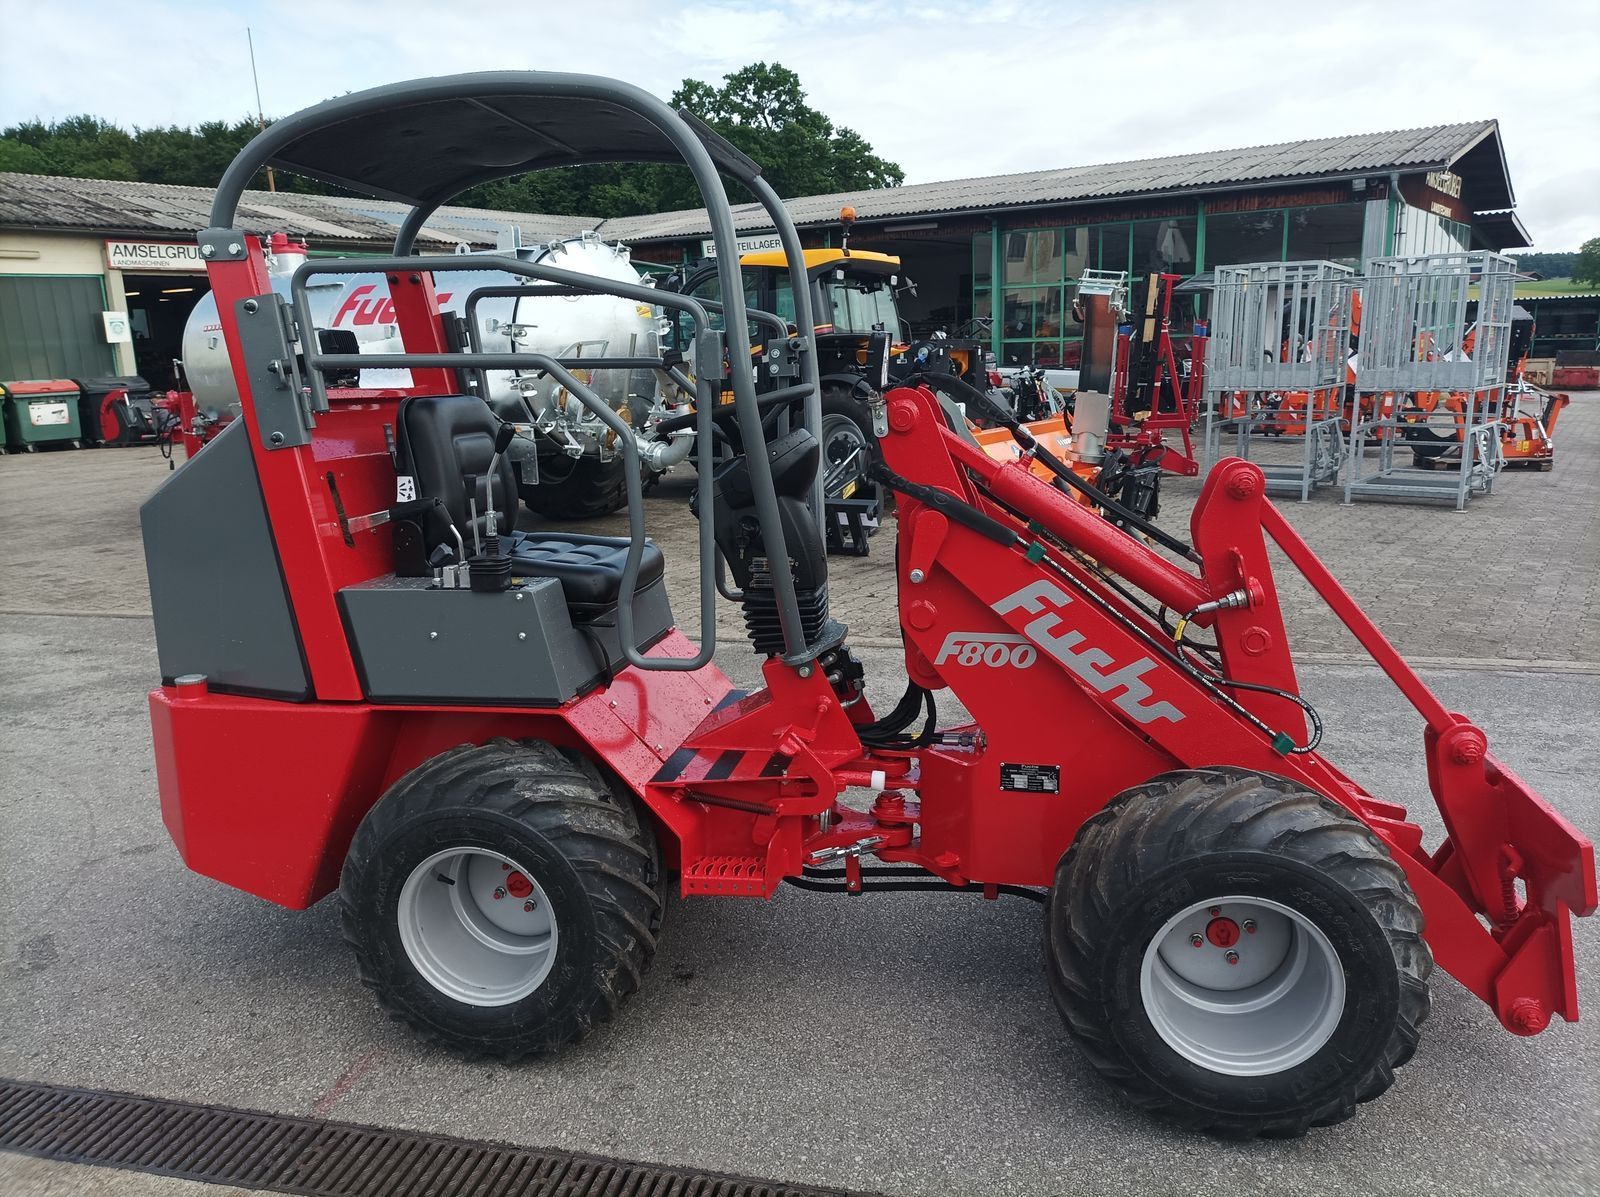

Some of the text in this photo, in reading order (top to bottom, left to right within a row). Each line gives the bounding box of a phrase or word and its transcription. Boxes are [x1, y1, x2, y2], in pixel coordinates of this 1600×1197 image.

[113, 259, 170, 267] LANDMASCHINEN
[934, 631, 1037, 669] F800
[990, 579, 1186, 724] Fuchs
